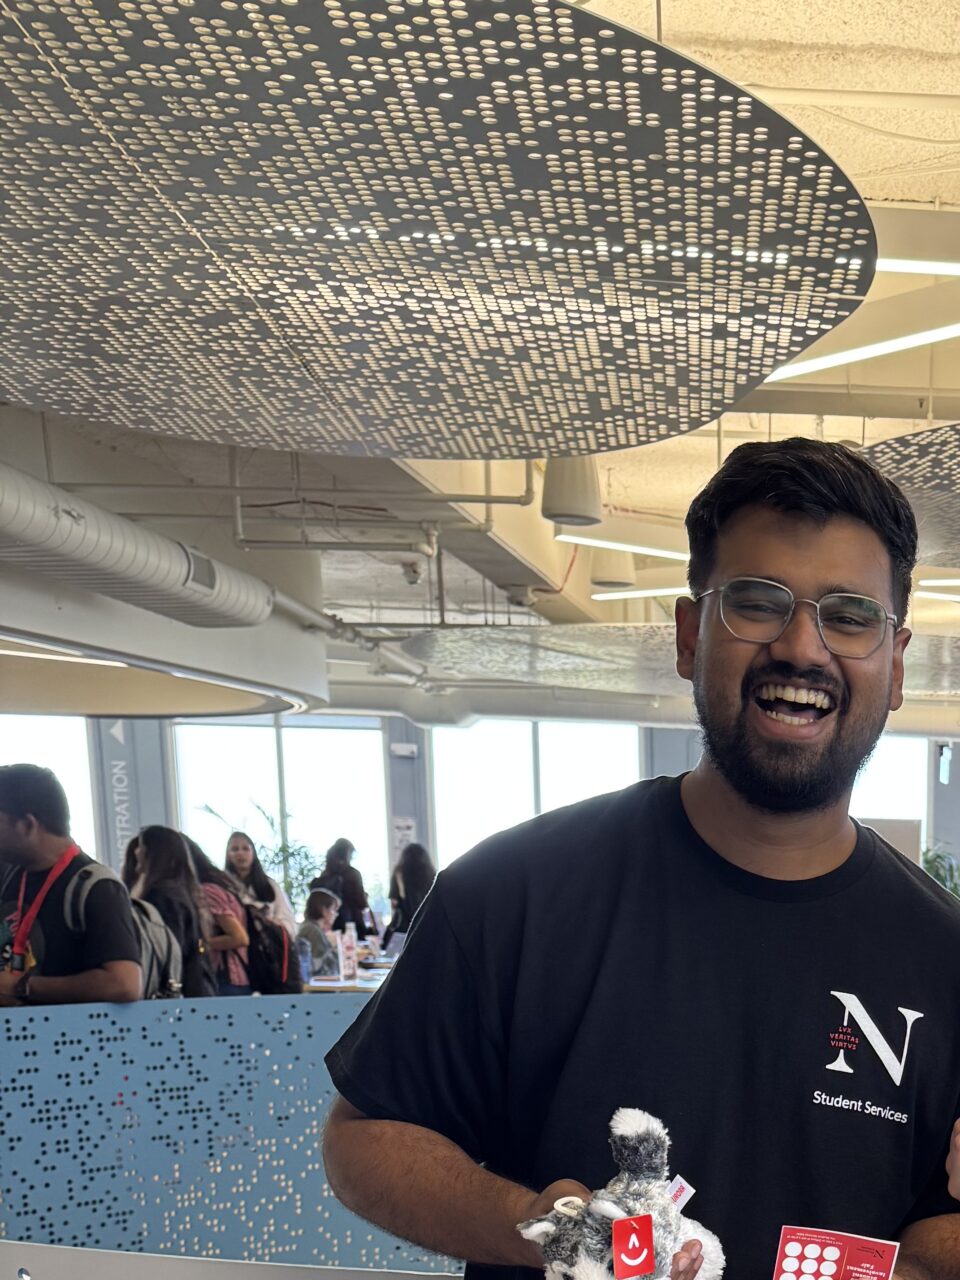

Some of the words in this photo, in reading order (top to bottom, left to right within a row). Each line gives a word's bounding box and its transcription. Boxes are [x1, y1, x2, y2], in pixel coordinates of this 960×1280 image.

[826, 990, 924, 1086] N
[830, 1033, 859, 1044] VERITAS
[813, 1091, 862, 1112] Student
[864, 1101, 908, 1124] Services
